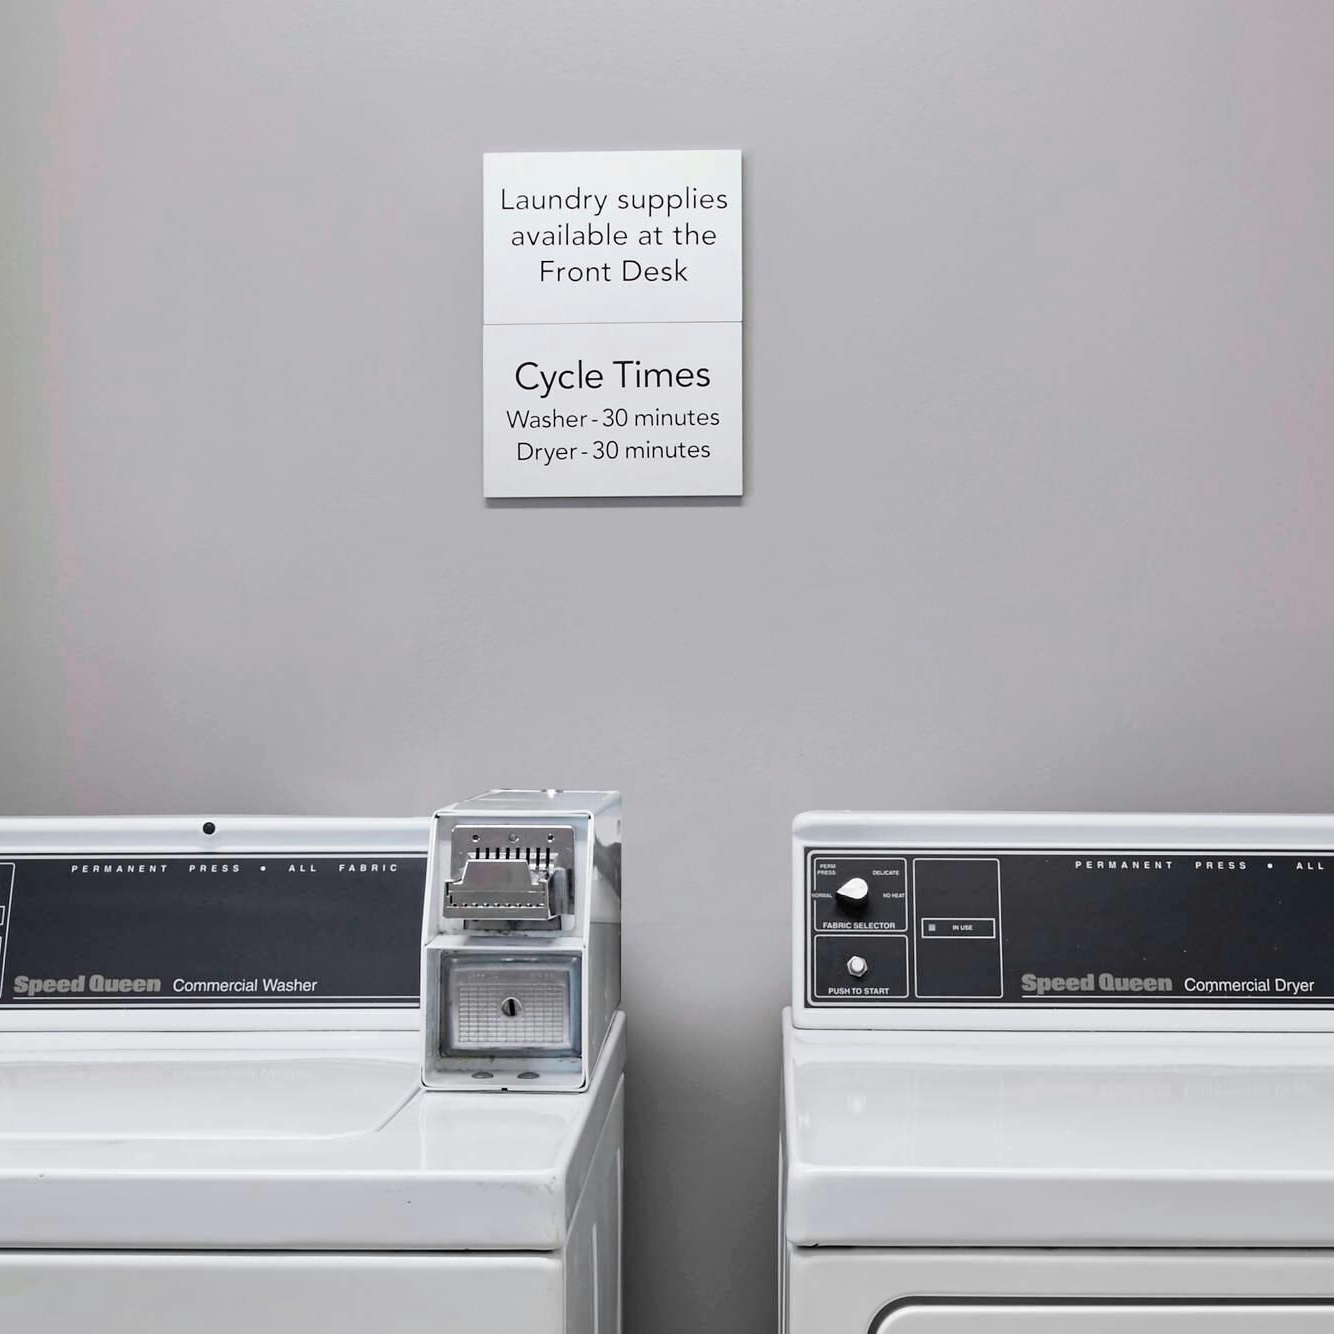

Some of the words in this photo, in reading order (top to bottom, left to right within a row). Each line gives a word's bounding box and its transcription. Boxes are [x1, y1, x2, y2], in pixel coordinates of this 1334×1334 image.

[502, 187, 607, 216] Laundry
[619, 186, 727, 217] supplies
[512, 223, 627, 246] available
[639, 227, 662, 245] at
[673, 223, 716, 245] the
[541, 261, 611, 281] Front
[623, 259, 687, 281] Desk
[516, 360, 603, 398] Cycle
[612, 361, 710, 388] Times
[635, 408, 719, 426] minutes
[626, 441, 710, 458] minutes
[71, 864, 167, 873] PERMANENT
[188, 864, 240, 873] PRESS
[288, 863, 316, 873] ALL
[338, 863, 397, 872] FABRIC
[1074, 860, 1172, 870] PERMANENT
[1195, 861, 1247, 870] PRESS
[1296, 861, 1324, 870] ALL
[822, 921, 852, 929] FABRIC
[853, 921, 896, 929] SELECTOR
[13, 976, 85, 996] Speed
[89, 975, 161, 992] Queen
[173, 979, 257, 992] Commercial
[263, 979, 317, 991] Washer
[828, 987, 852, 995] PUSH
[852, 987, 863, 995] TO
[863, 987, 890, 995] START
[1021, 974, 1094, 995] Speed
[1099, 973, 1172, 991] Queen
[1185, 978, 1270, 992] Commercial
[1275, 979, 1314, 995] Dryer
